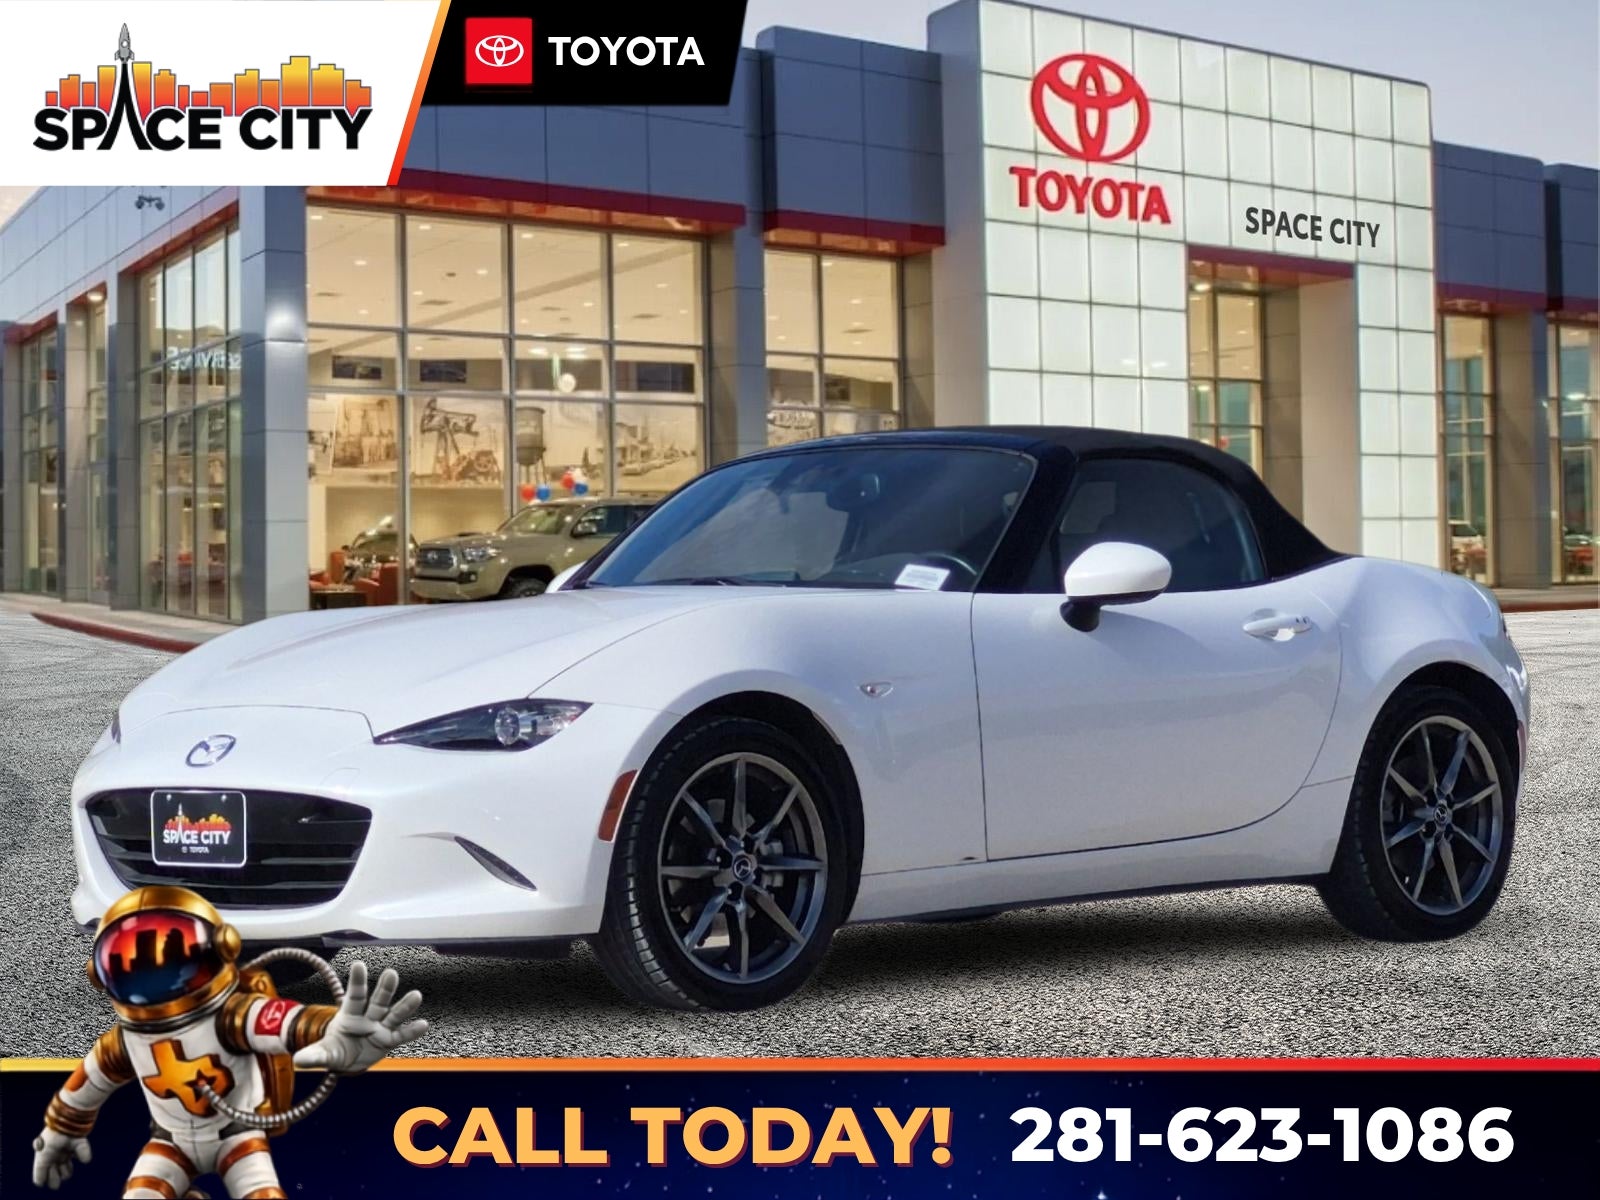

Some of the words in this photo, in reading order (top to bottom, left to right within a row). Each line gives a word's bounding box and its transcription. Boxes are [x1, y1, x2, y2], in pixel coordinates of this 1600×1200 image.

[1009, 166, 1171, 224] TOYOTA
[1245, 207, 1323, 242] SPACE
[1330, 218, 1380, 248] CITY
[163, 829, 198, 844] SPACE
[201, 830, 231, 845] CITY
